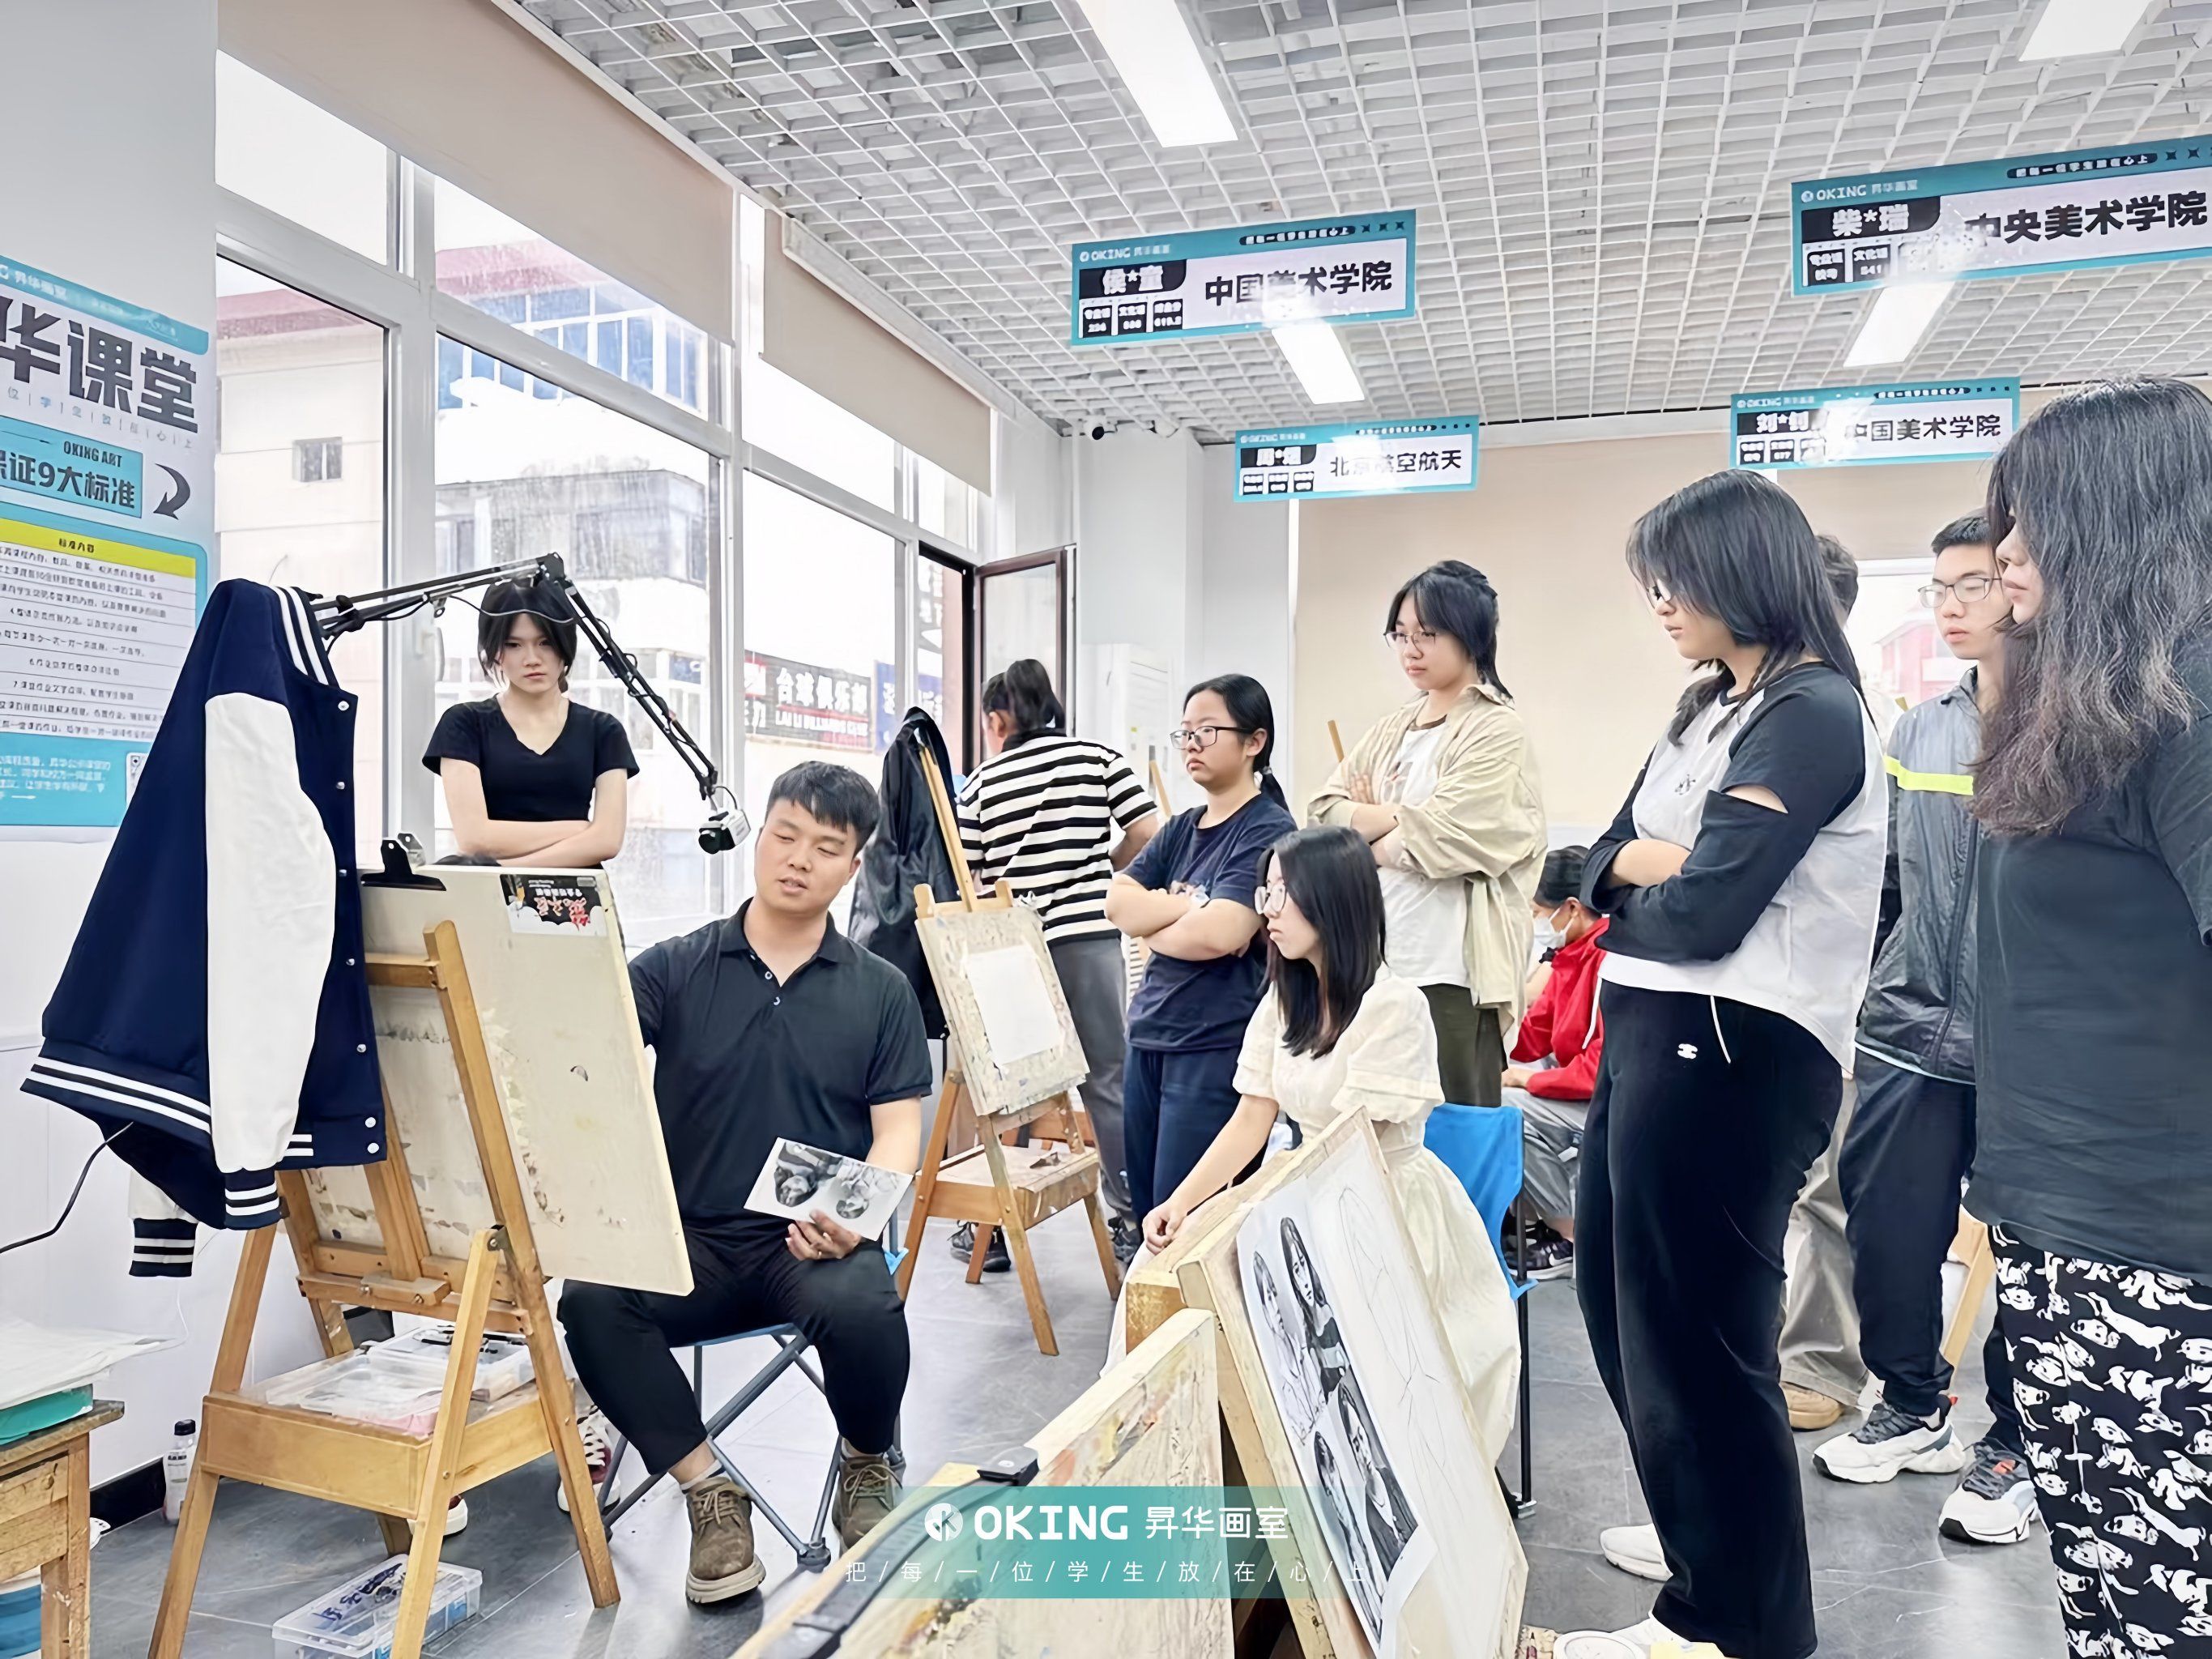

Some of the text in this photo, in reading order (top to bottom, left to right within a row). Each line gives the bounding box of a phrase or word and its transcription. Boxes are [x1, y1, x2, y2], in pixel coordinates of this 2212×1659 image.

[1816, 185, 1867, 201] OKING
[1964, 190, 2208, 247] 中央美术学院
[1330, 450, 1462, 477] 北空航天
